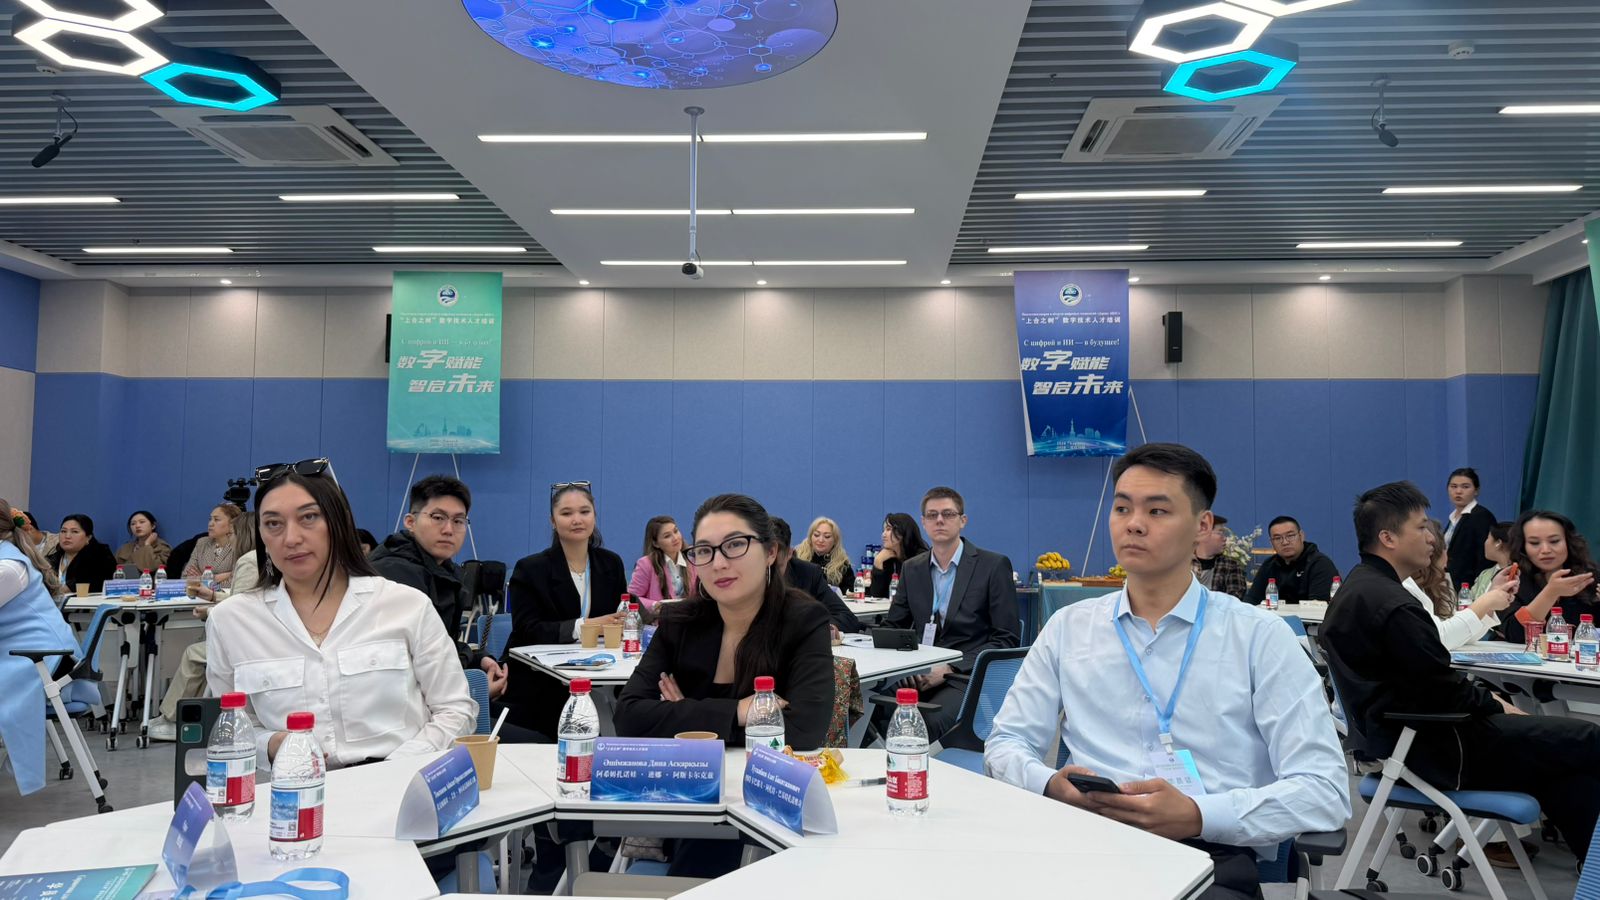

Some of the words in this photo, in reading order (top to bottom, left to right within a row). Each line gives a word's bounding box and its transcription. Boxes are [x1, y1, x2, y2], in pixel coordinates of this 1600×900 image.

[396, 349, 484, 369] 数字赋能
[1020, 350, 1111, 371] 数字赋能
[408, 373, 495, 393] 智启未来
[1032, 374, 1124, 395] 智启未来
